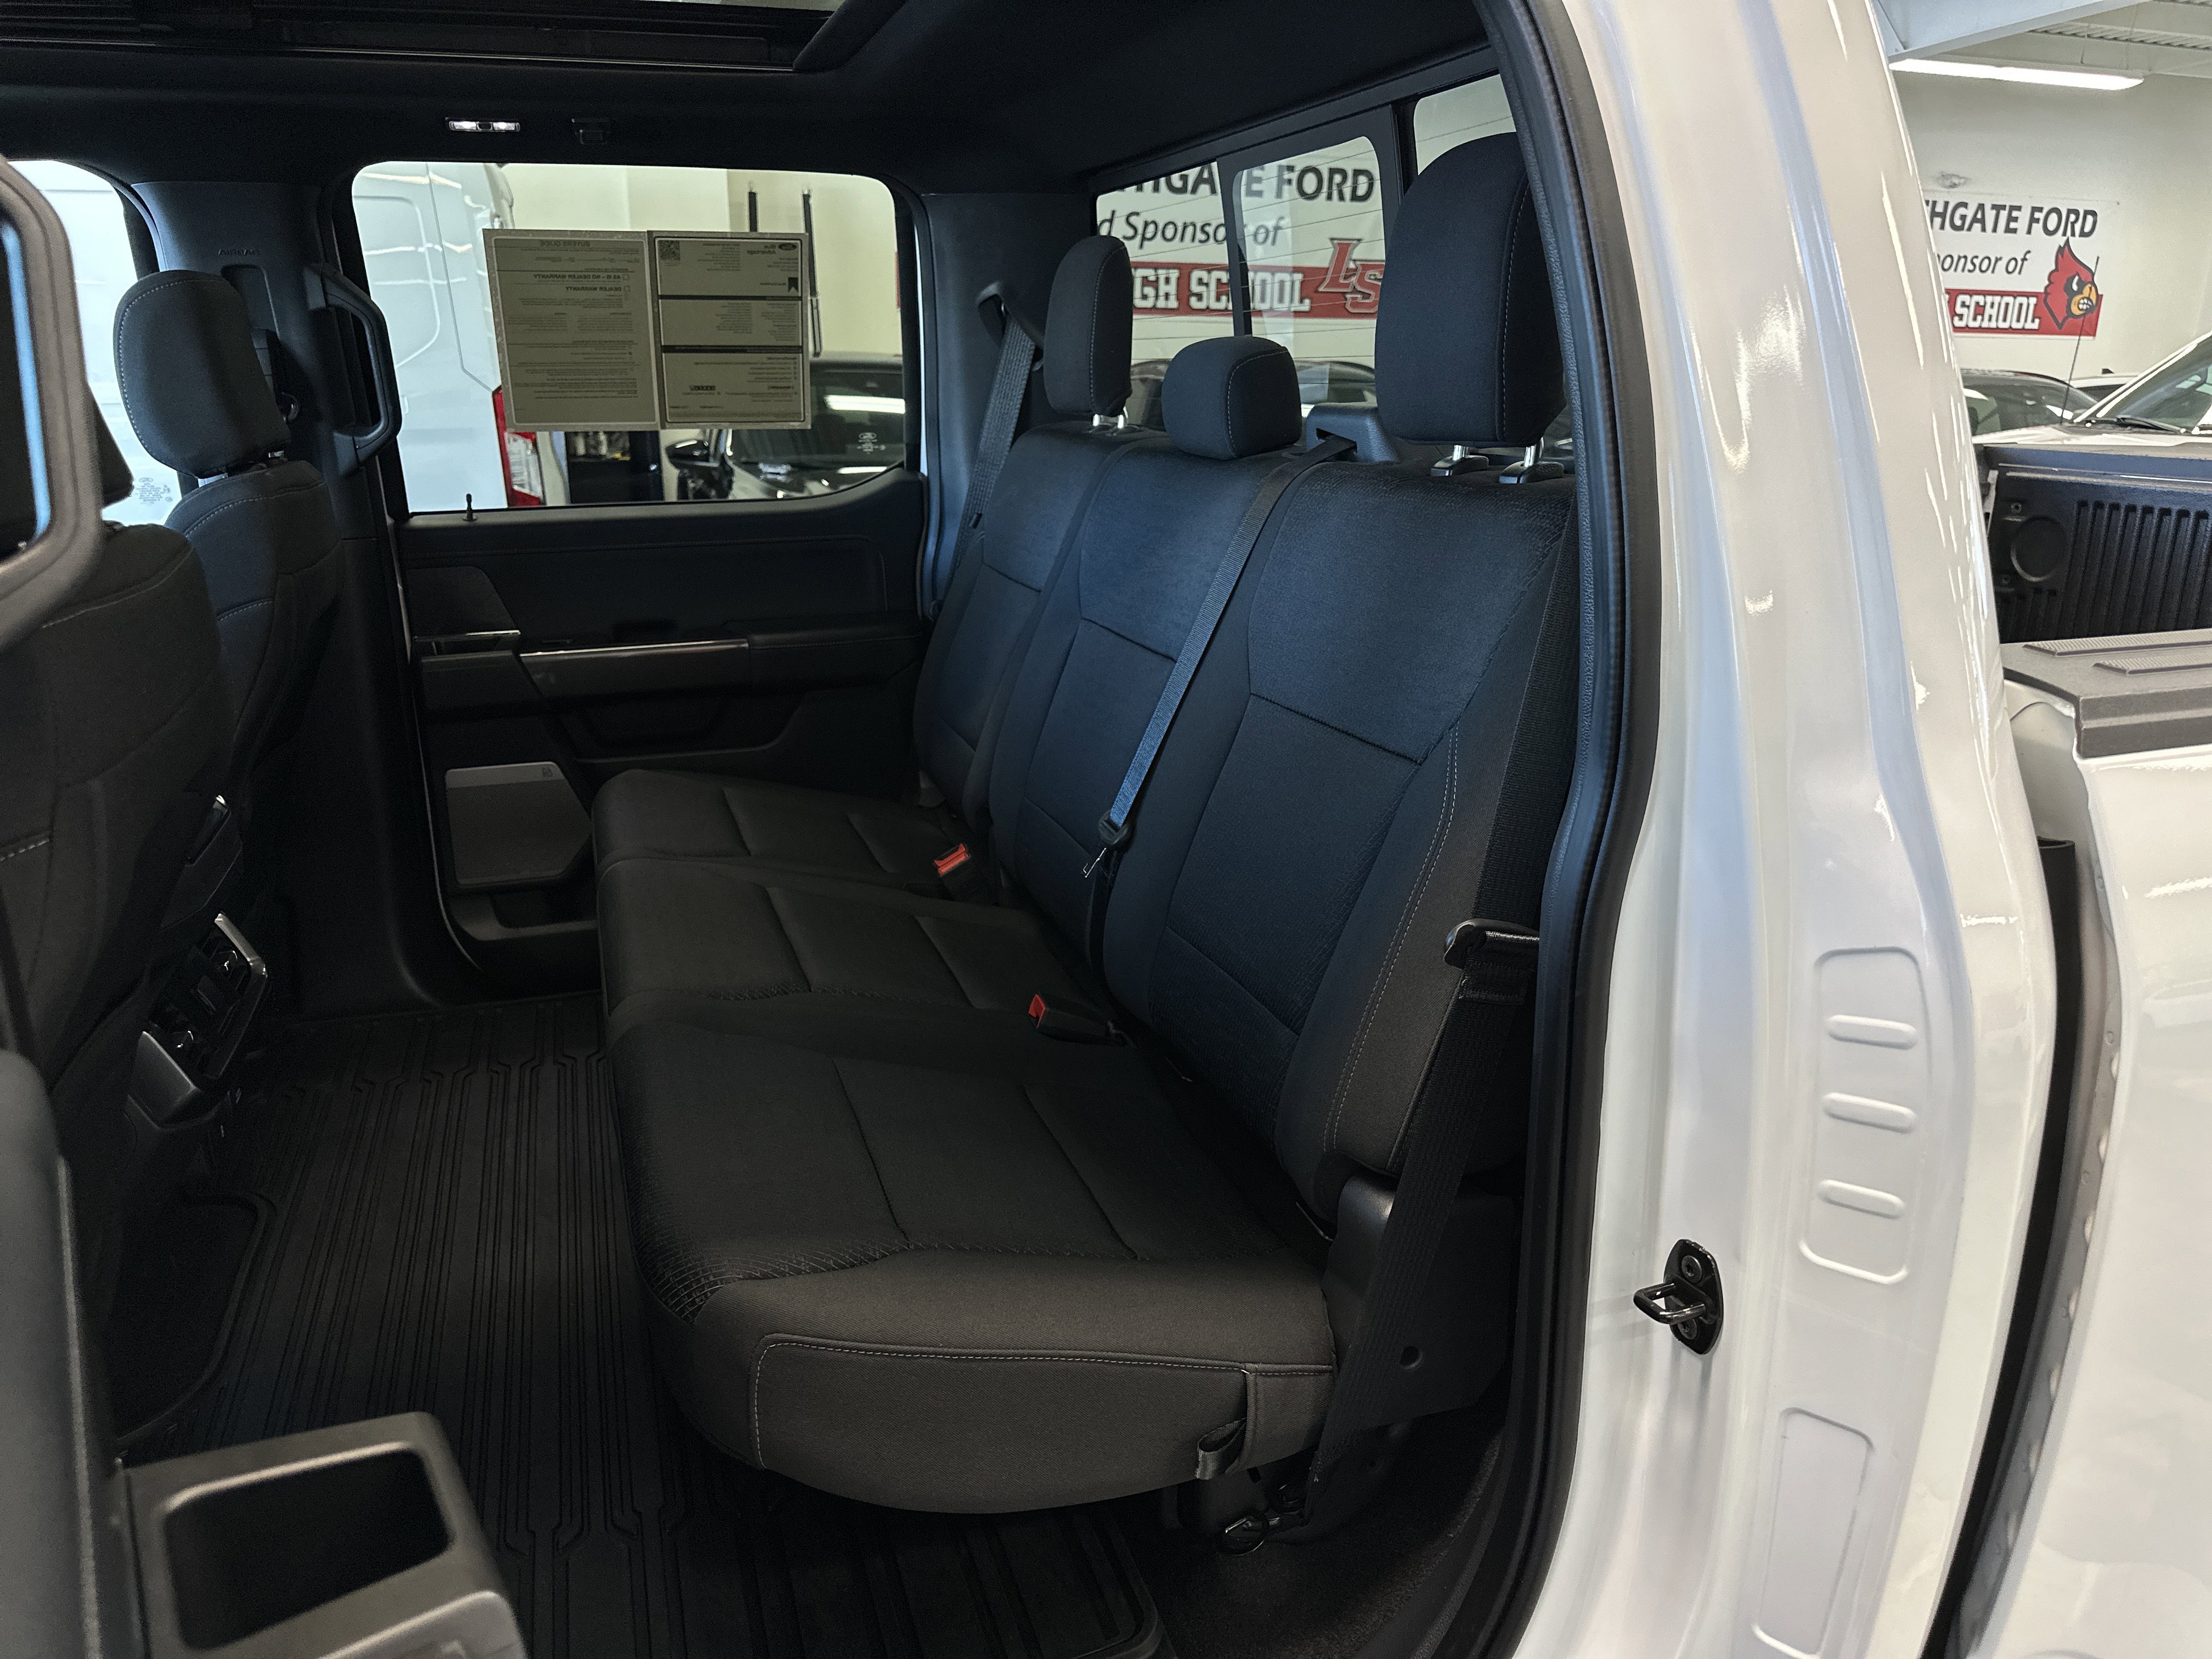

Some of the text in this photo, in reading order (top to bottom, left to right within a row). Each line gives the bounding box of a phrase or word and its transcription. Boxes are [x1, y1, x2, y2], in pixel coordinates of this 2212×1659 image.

[1274, 164, 1374, 202] FORD
[1253, 216, 1284, 246] of
[1925, 199, 2098, 238] HGATE FORD
[1937, 250, 2032, 275] onsor of
[1953, 294, 2040, 330] SCHOOL
